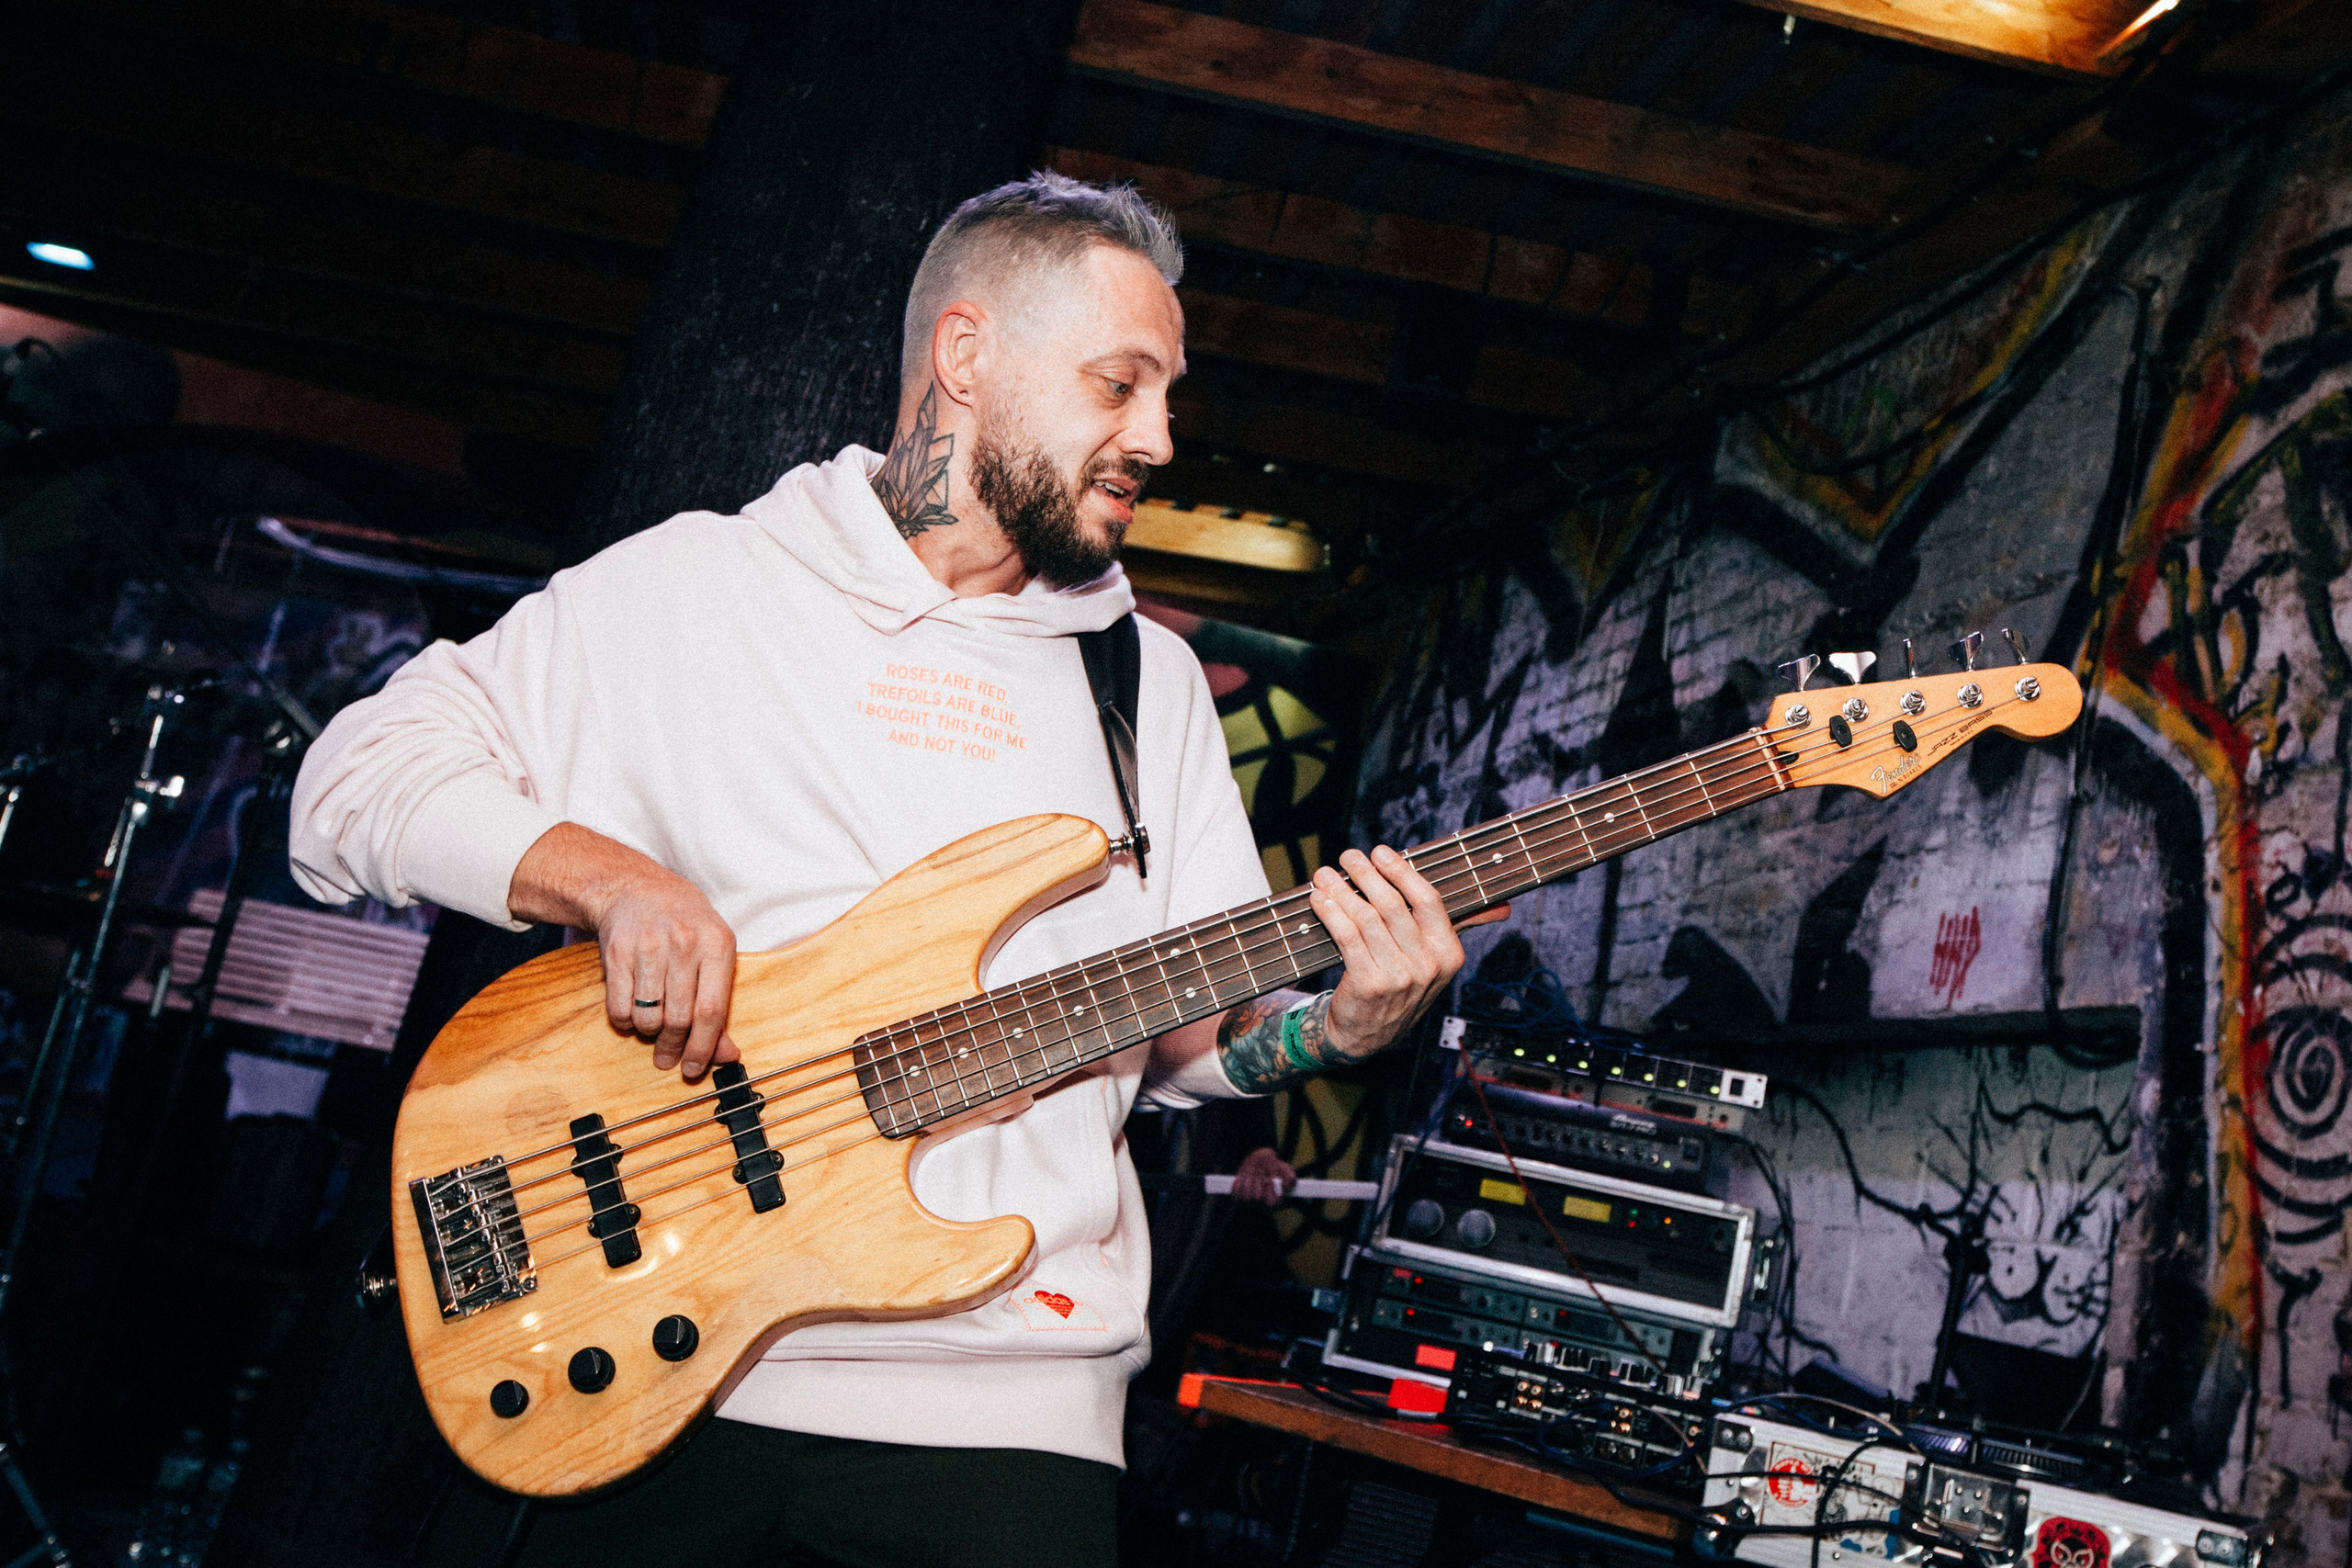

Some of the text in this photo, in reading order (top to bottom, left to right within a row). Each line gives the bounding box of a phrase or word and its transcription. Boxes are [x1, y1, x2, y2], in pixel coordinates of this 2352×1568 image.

[867, 682, 1021, 729] TREFOILS ARE BLUE,
[886, 663, 1009, 705] ROSES ARE RED,
[857, 699, 1027, 750] I BOUGHT THIS FOR ME
[888, 728, 996, 762] AND NOT YOU!
[1928, 731, 1958, 756] JAZZ
[1959, 710, 1993, 733] BASS
[1870, 755, 1921, 795] Fender
